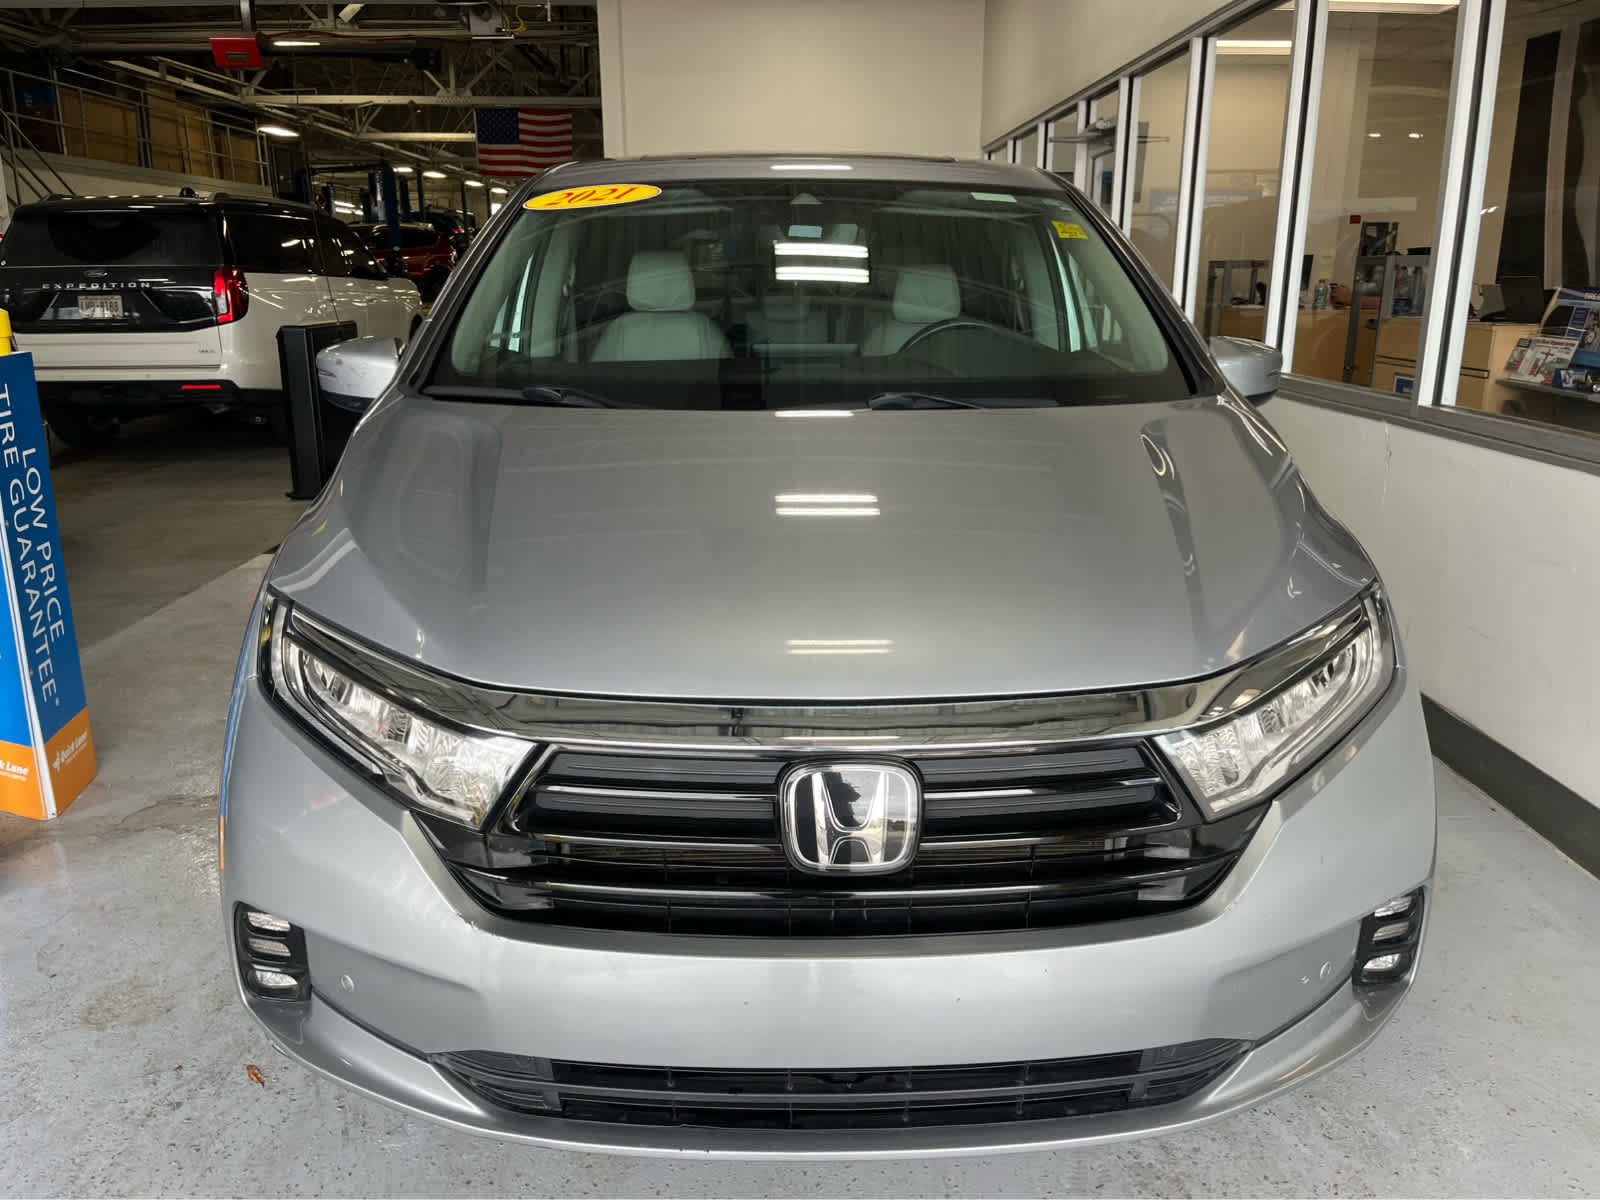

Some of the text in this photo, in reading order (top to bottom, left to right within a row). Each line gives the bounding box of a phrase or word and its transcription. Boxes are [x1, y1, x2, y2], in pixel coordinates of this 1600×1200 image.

[544, 187, 639, 206] 2021
[42, 281, 151, 289] EXPEDITION
[0, 383, 19, 468] TIRE
[22, 448, 64, 643] LOW PRICE
[6, 761, 29, 776] Lane
